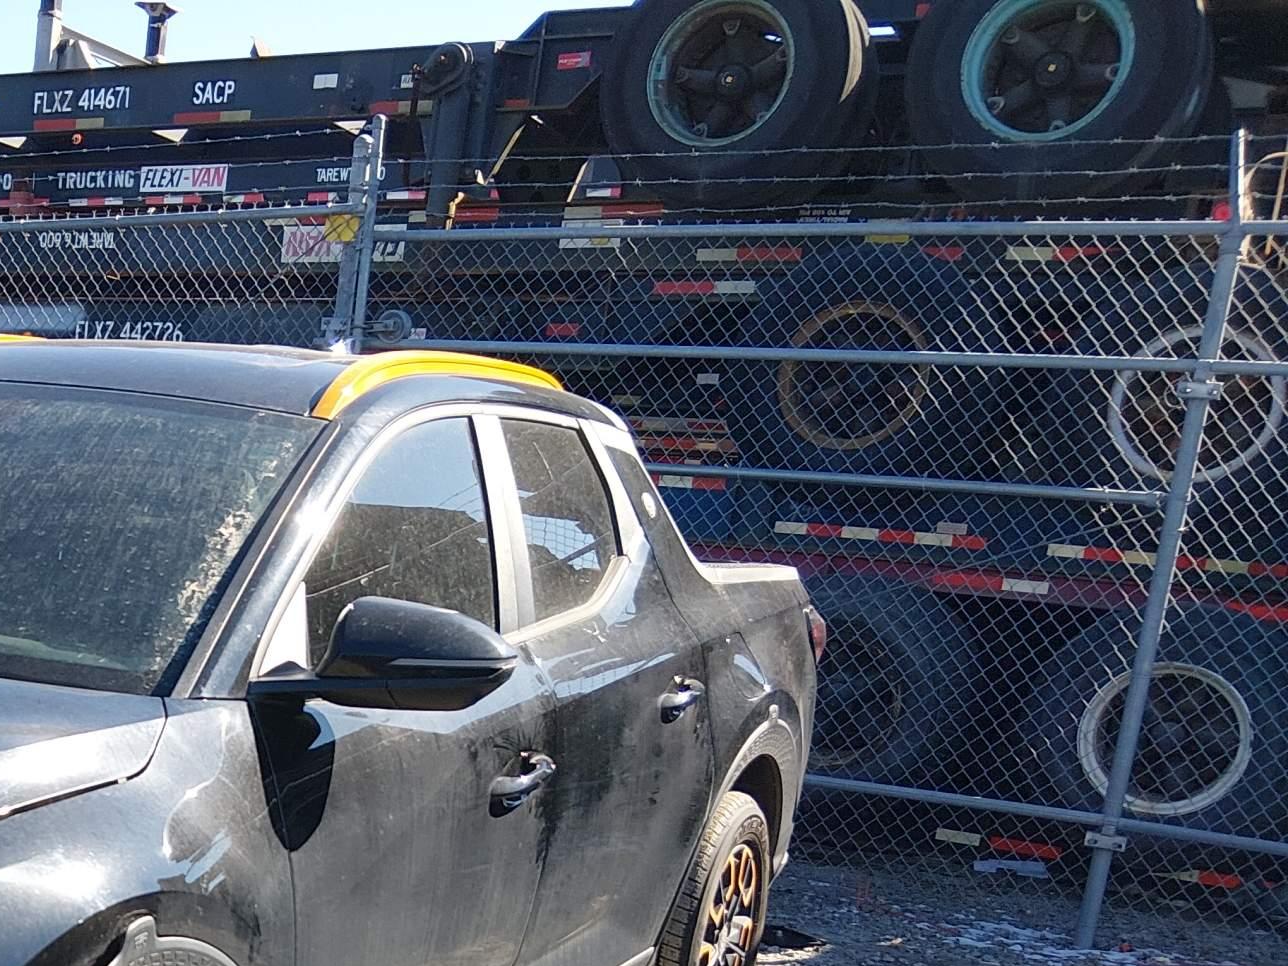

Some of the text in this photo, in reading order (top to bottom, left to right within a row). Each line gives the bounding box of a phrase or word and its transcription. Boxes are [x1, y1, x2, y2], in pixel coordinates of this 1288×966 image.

[33, 86, 131, 114] FLXZ 414671
[192, 80, 236, 105] SACP
[57, 169, 135, 190] TRUCKING
[141, 167, 226, 189] FLEXI-VAN
[120, 321, 183, 341] 442726
